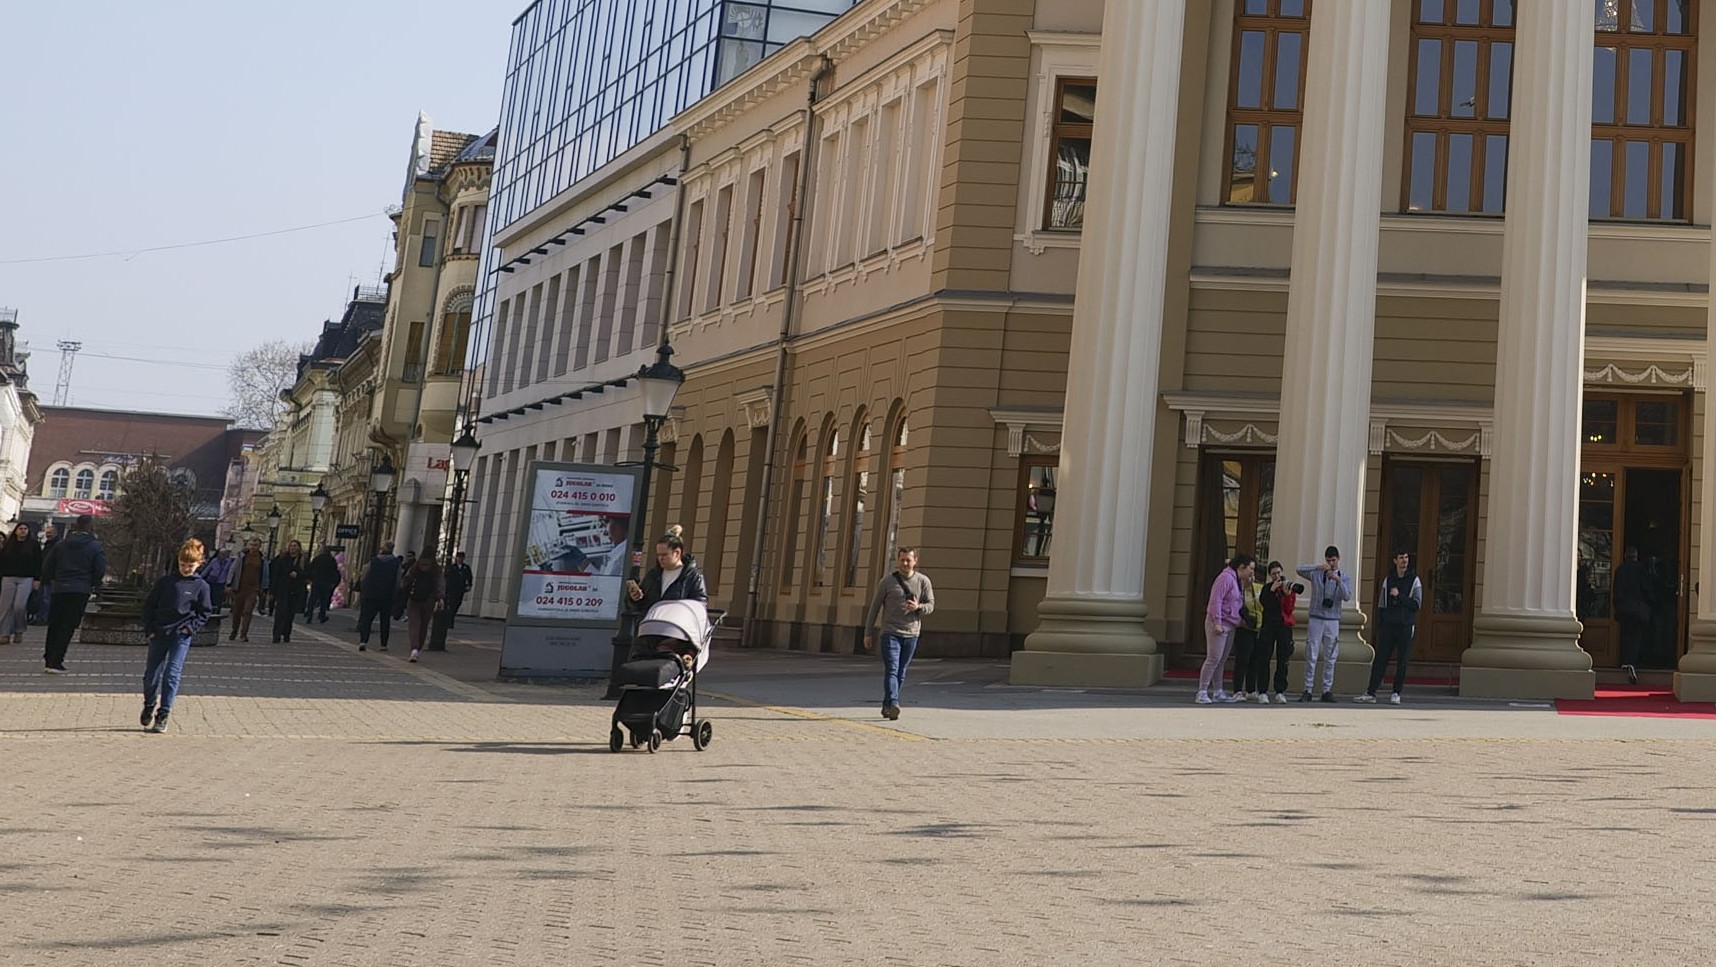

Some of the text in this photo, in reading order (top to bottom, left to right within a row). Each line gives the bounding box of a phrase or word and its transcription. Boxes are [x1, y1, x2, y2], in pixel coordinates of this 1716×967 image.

[551, 490, 616, 502] 024 415 0 010
[536, 596, 603, 607] 024 415 0 209
